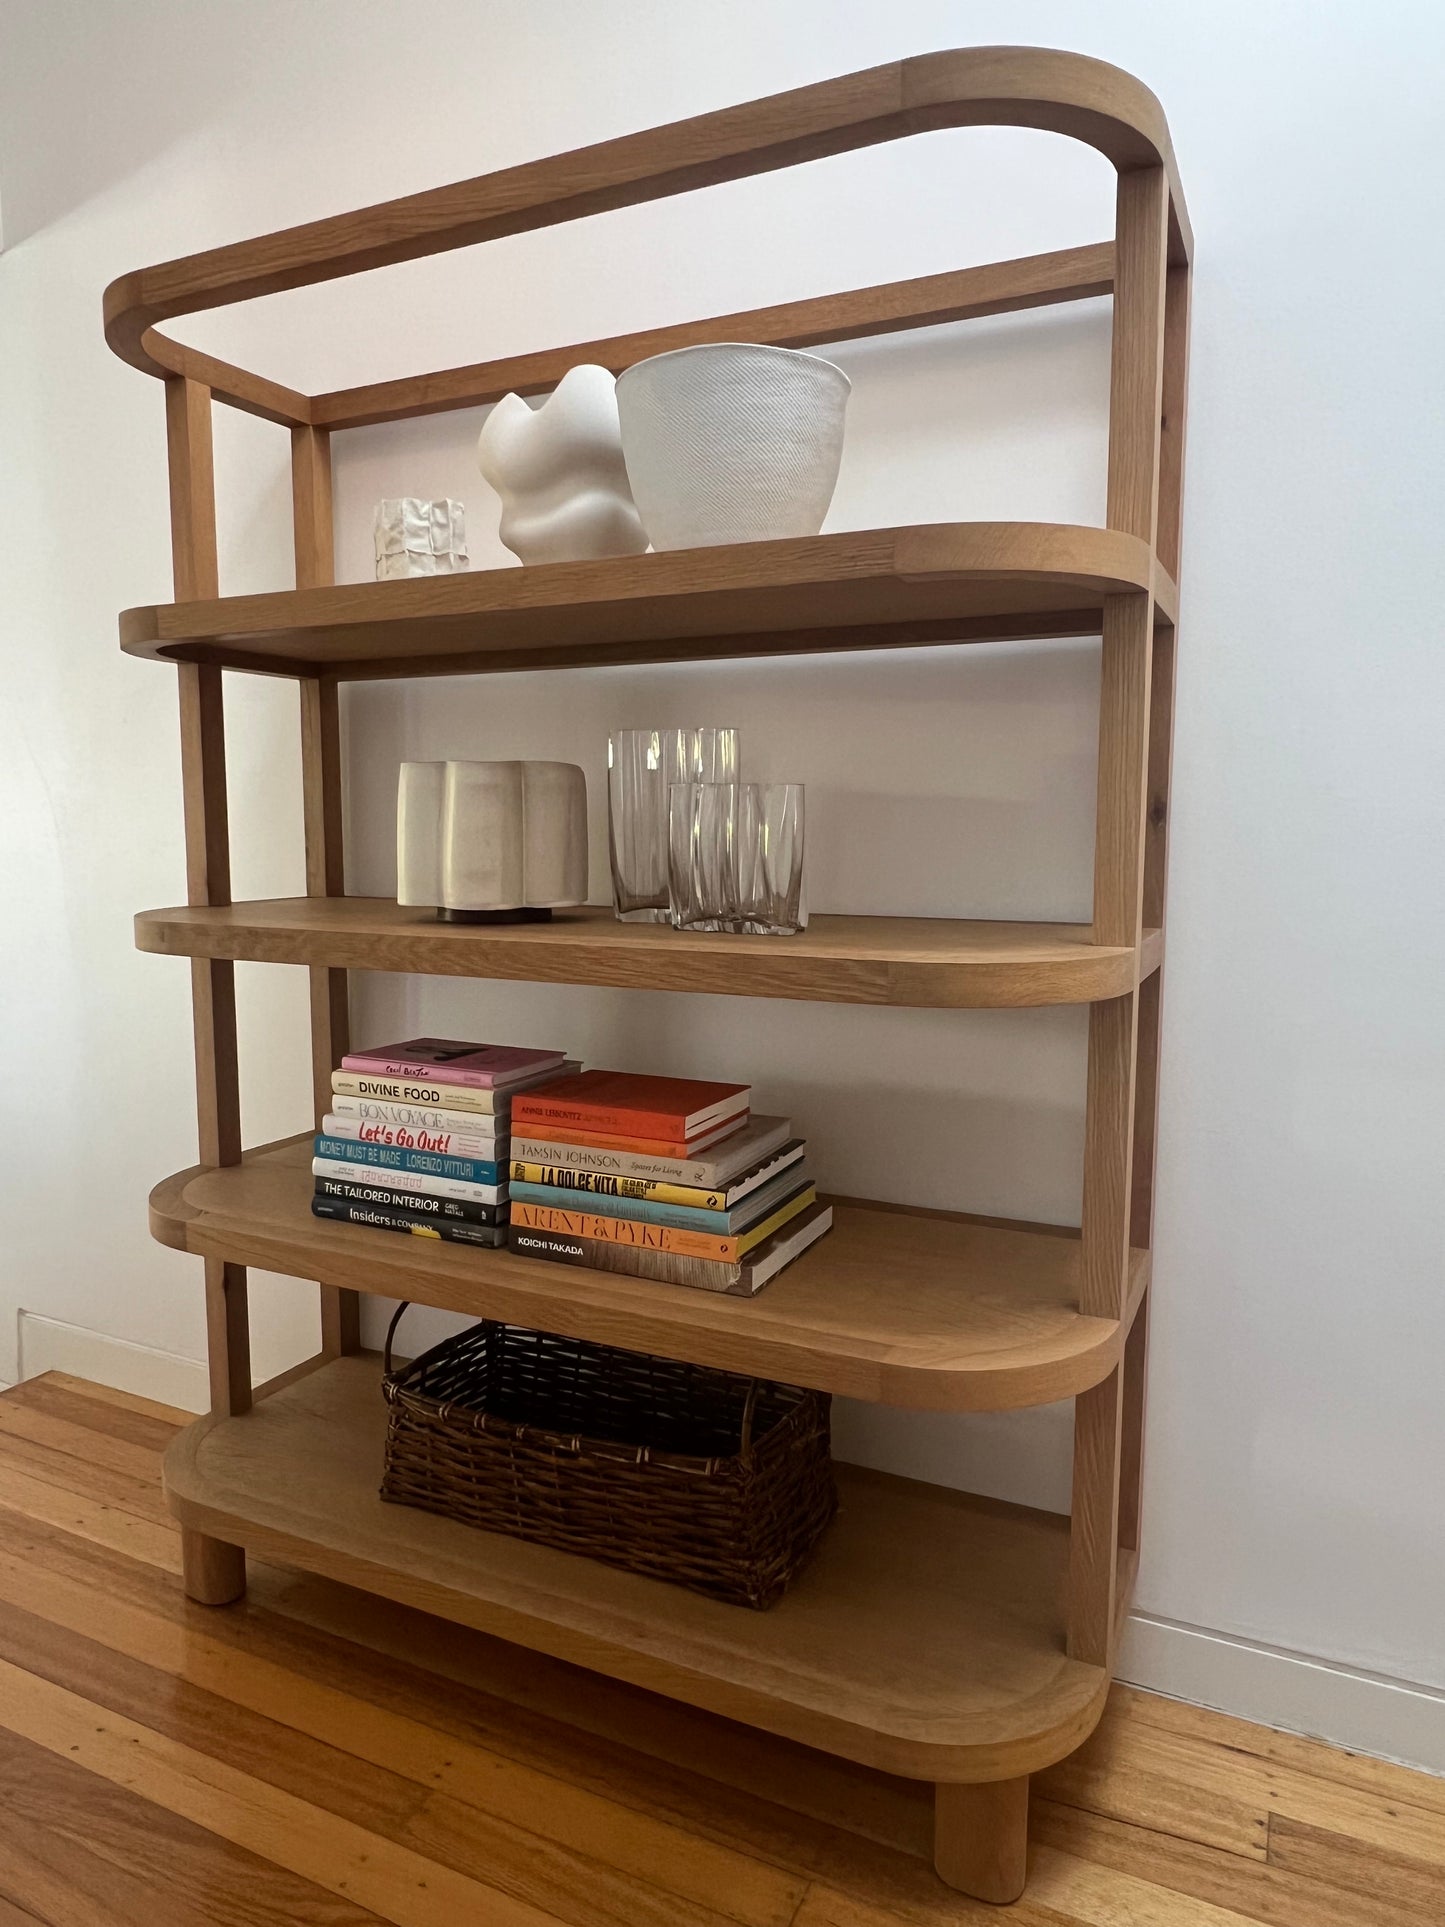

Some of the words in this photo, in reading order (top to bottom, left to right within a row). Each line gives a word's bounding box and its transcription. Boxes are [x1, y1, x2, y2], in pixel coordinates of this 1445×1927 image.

[358, 1081, 400, 1098] DIVINE
[404, 1087, 440, 1102] FOOD
[359, 1102, 388, 1121] BON
[390, 1107, 445, 1129] VOYAGE
[358, 1121, 393, 1145] Let's
[396, 1127, 414, 1149] Go
[417, 1130, 451, 1153] Out!
[319, 1140, 345, 1156] MONEY
[345, 1144, 367, 1160] MUST
[368, 1147, 378, 1162] BE
[379, 1149, 401, 1166] MADE
[406, 1153, 442, 1173] LORENZO
[444, 1160, 474, 1177] VITTURI
[520, 1144, 562, 1160] TAMSIN
[566, 1150, 622, 1168] JOHNSON
[541, 1166, 555, 1184] LA
[556, 1169, 592, 1192] DOLCE
[593, 1175, 619, 1196] VITA
[324, 1182, 342, 1195] THE
[344, 1185, 391, 1204] TAILORED
[392, 1196, 439, 1212] INTERIOR
[350, 1208, 390, 1226] Insiders
[516, 1206, 589, 1235] ARENT
[594, 1219, 608, 1238] &
[614, 1220, 671, 1249] PYKE
[517, 1236, 548, 1250] KOICHI
[548, 1241, 584, 1256] TAKADA
